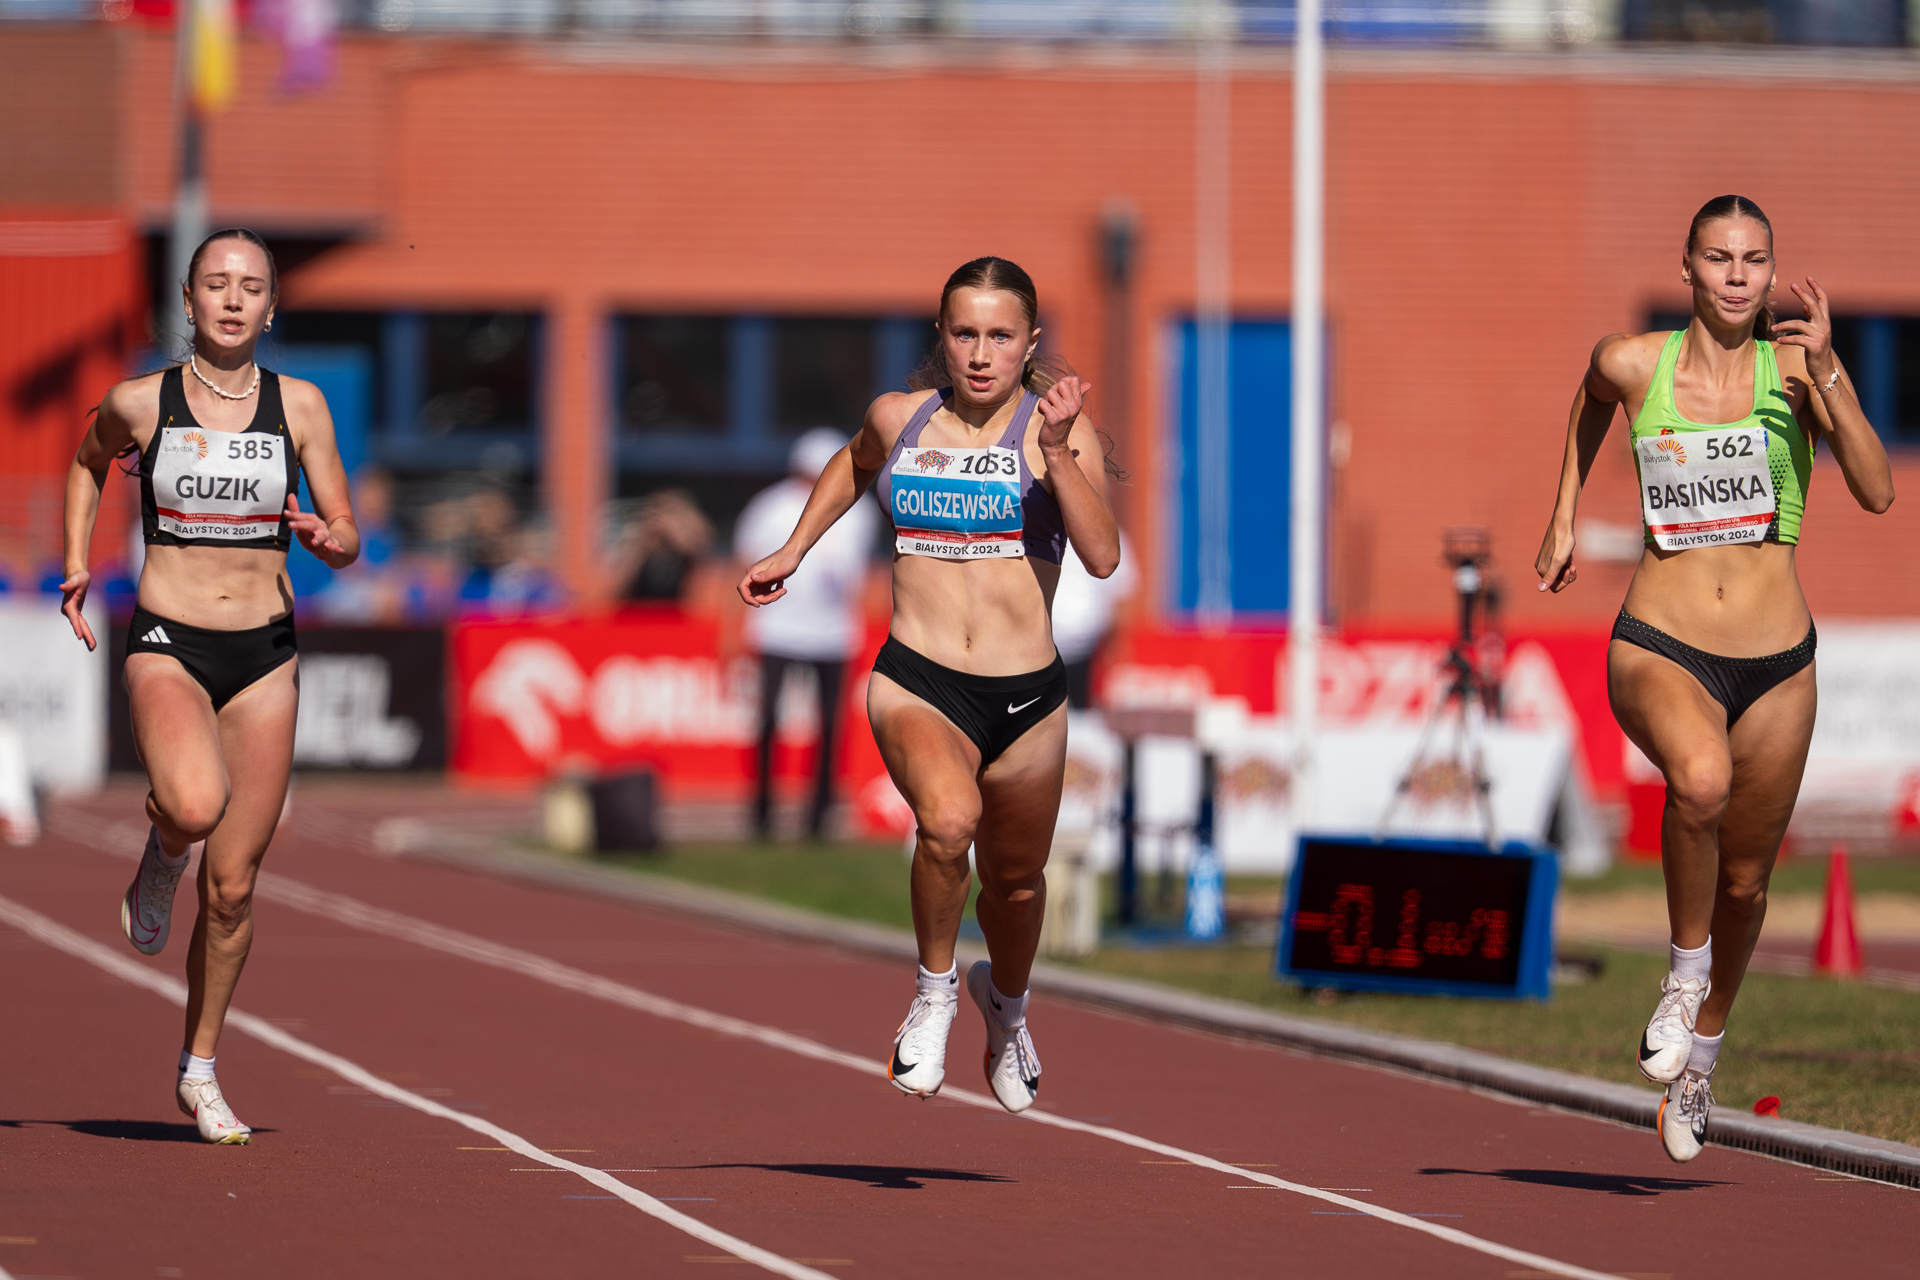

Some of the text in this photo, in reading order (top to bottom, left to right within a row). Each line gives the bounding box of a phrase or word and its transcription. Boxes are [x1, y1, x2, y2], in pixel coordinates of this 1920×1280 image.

[228, 440, 273, 460] 585
[1706, 435, 1754, 460] 562
[960, 453, 1017, 476] 1053
[175, 474, 261, 502] GUZIK
[1647, 474, 1768, 510] BASIŃSKA
[895, 488, 1017, 520] GOLISZEWSKA
[174, 523, 257, 536] BIAŁYSTOK 2024
[1667, 529, 1756, 546] BIAŁYSTOK 2024
[915, 542, 1001, 555] BIAŁYSTOK 2024
